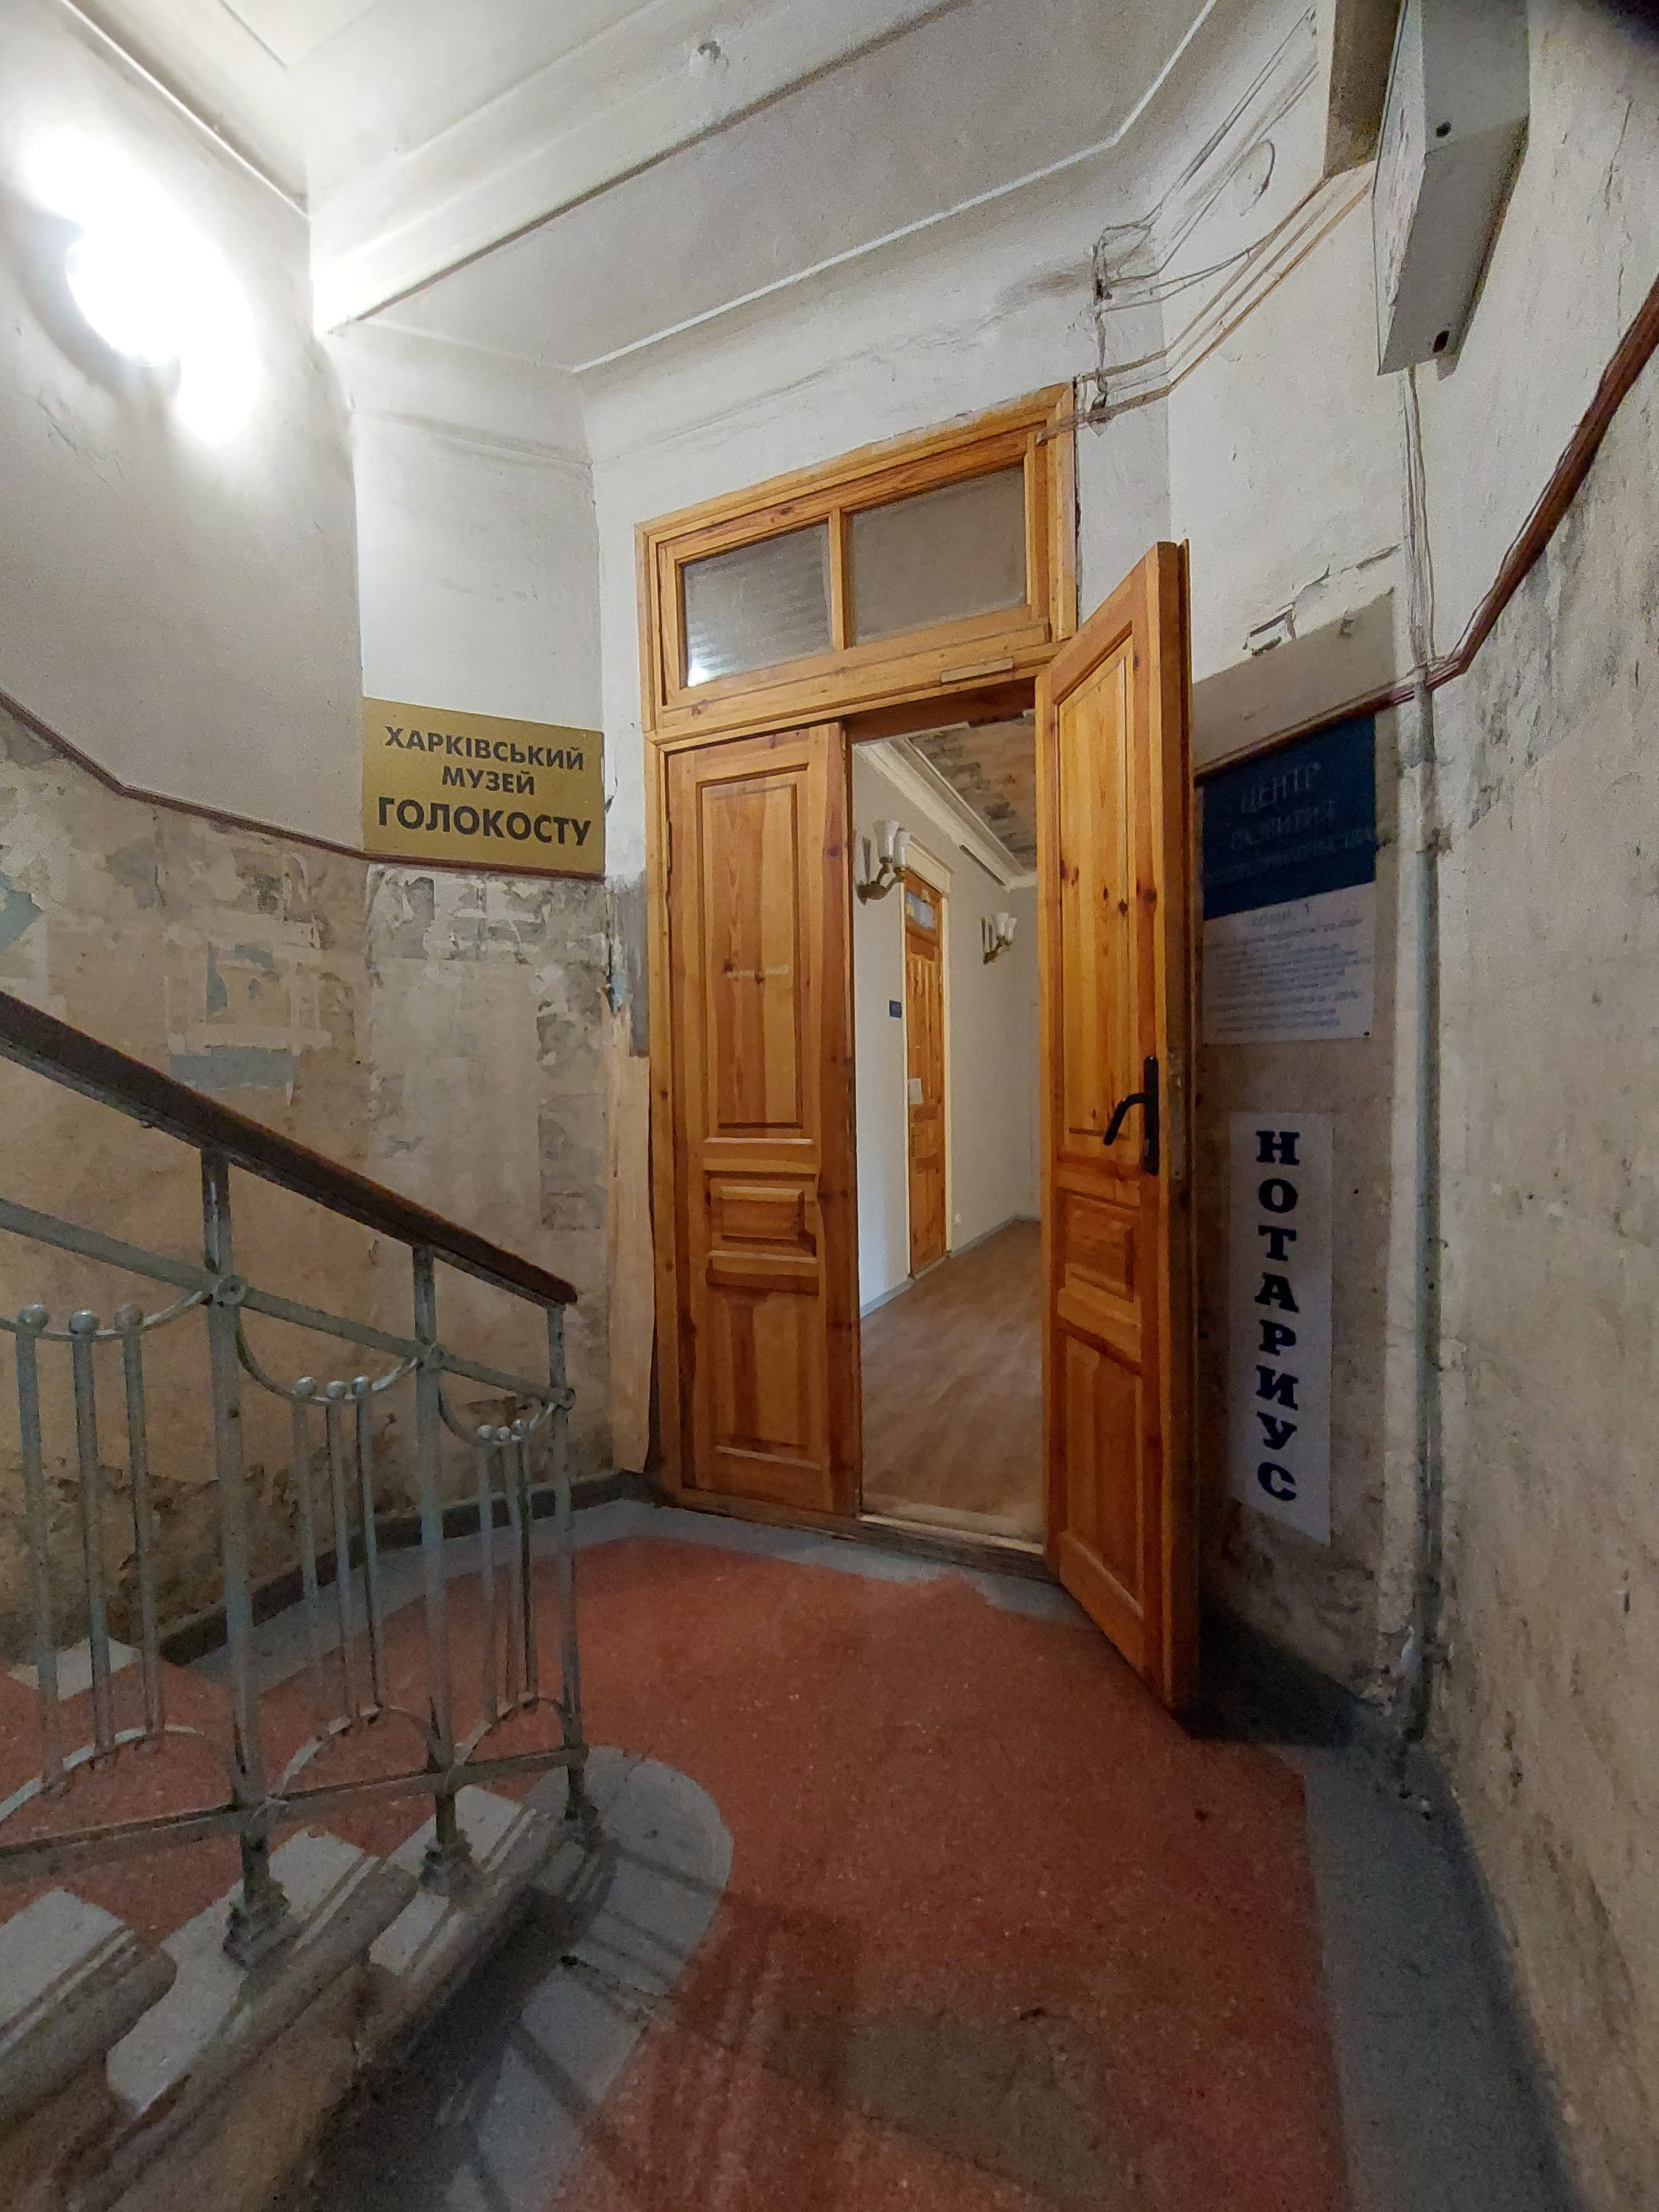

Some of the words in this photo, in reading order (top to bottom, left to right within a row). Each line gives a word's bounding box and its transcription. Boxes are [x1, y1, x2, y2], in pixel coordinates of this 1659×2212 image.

[384, 725, 584, 771] ХАРКІВСЬКИЙ
[442, 765, 535, 795] МУЗЕЙ
[1240, 761, 1322, 814] ЦЕНТР
[378, 796, 592, 846] ГОЛОКОСТУ
[1254, 1130, 1300, 1501] НОТАРИУС
